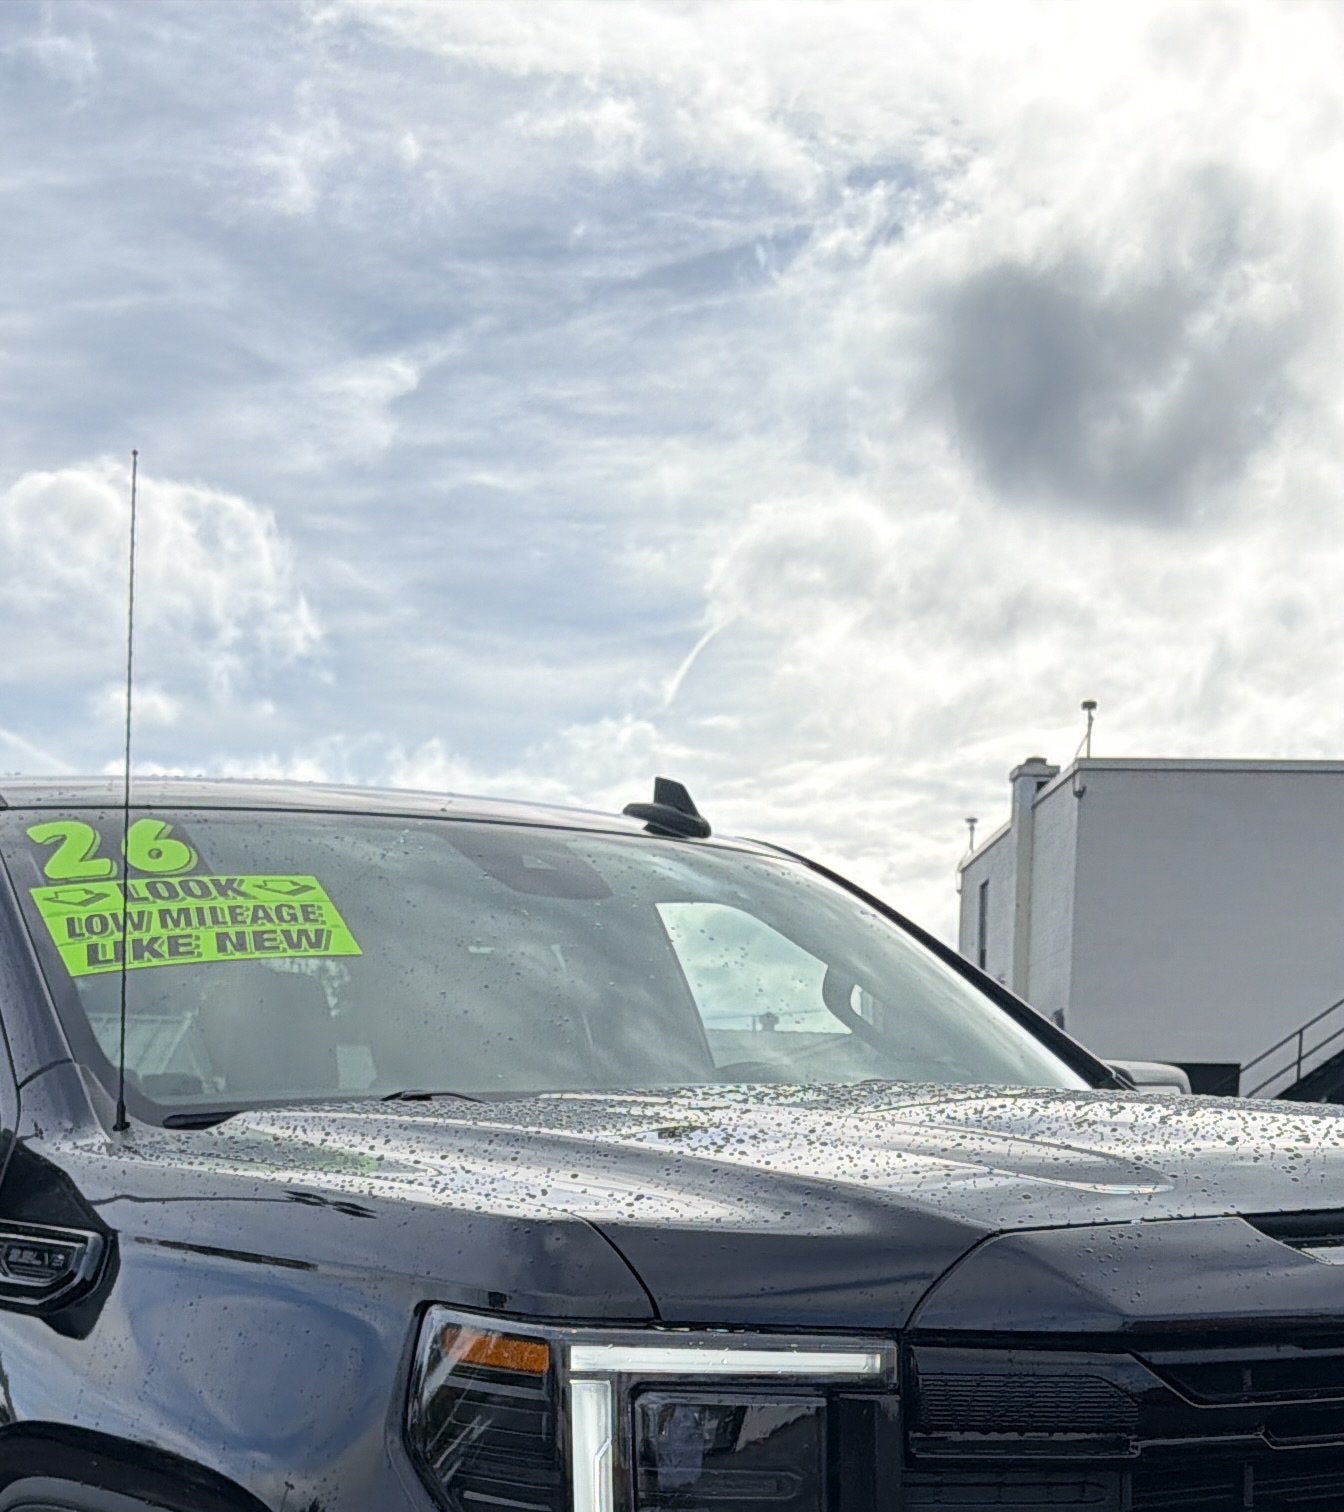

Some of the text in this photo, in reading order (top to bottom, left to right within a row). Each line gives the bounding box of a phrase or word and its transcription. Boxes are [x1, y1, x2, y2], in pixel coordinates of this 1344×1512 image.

[26, 818, 197, 880] 26
[117, 878, 253, 904] LOOK
[67, 903, 326, 940] LOW MILEAGE
[86, 929, 331, 968] LIKE NEW
